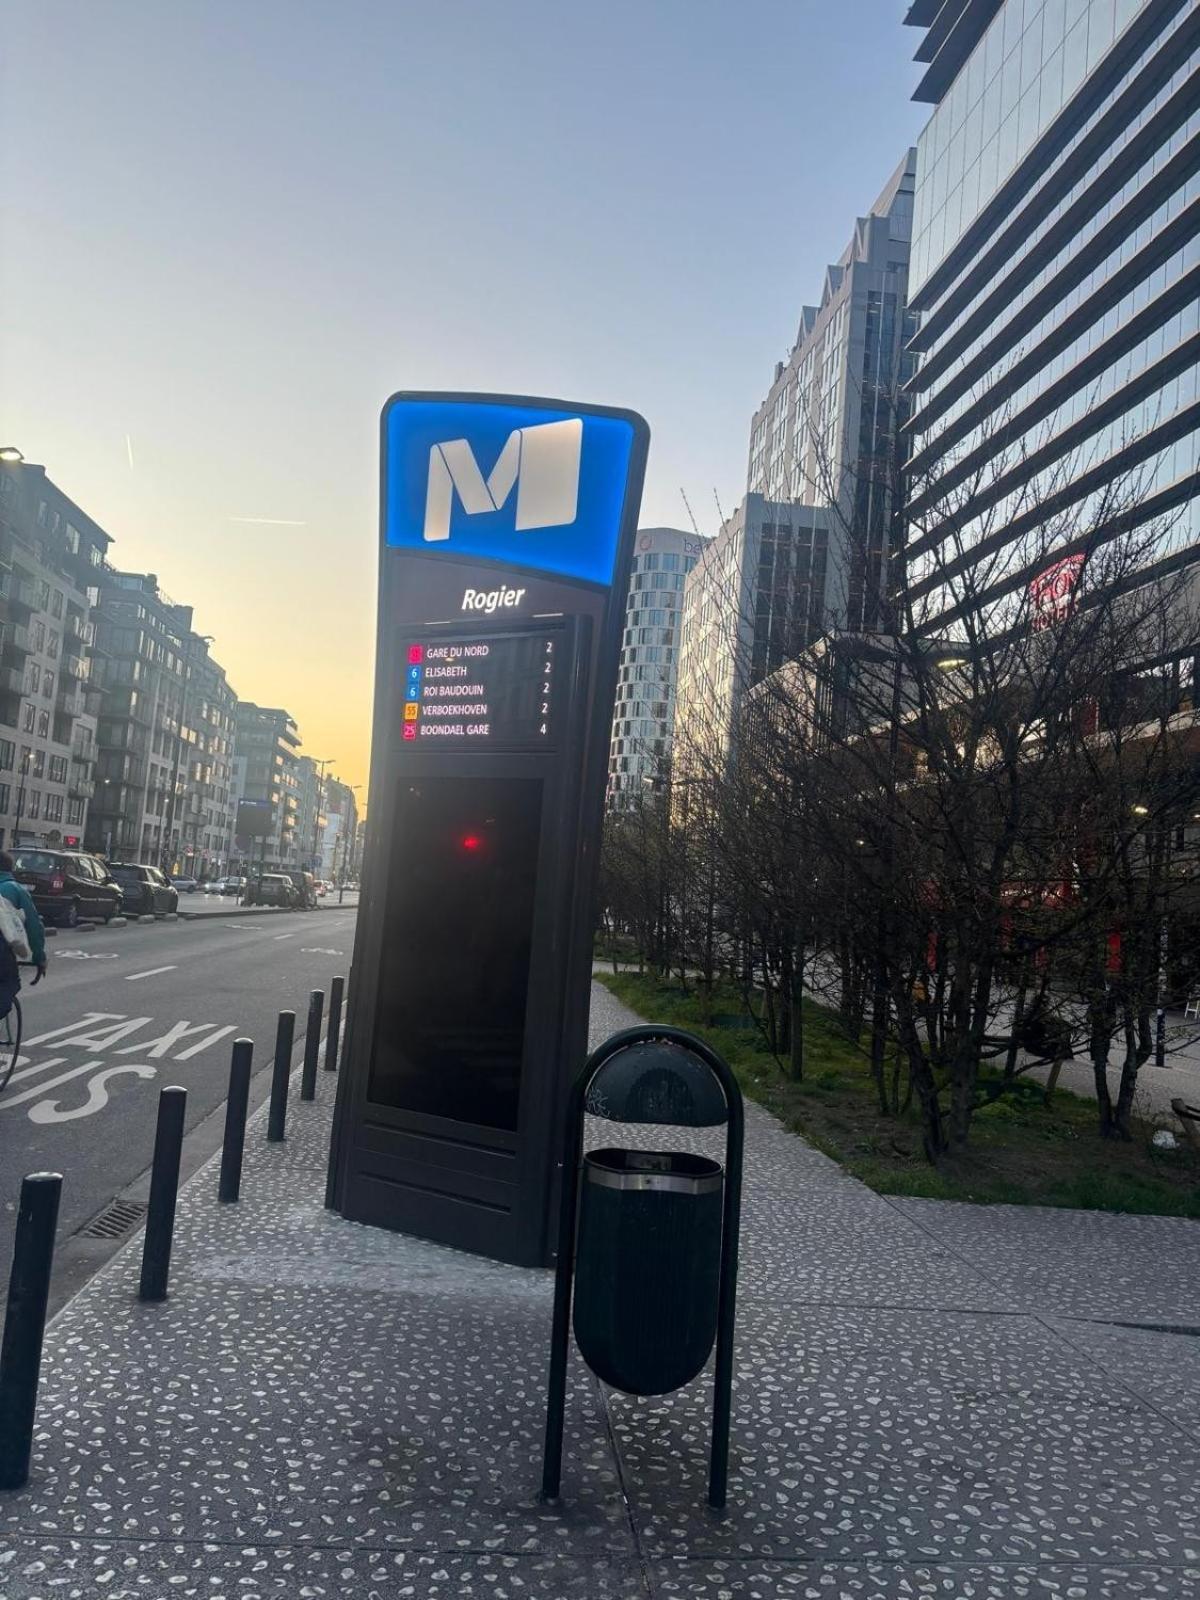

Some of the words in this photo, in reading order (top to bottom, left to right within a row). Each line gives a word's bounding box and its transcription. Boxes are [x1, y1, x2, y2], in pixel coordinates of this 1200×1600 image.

[462, 585, 526, 613] Rogier
[426, 648, 449, 659] GARE
[450, 647, 462, 657] DU
[464, 645, 489, 657] NORD
[546, 642, 552, 653] 2
[411, 668, 417, 679] 6
[425, 666, 467, 678] ELISABETH
[544, 662, 551, 673] 2
[409, 687, 416, 697] 6
[423, 685, 438, 697] ROI
[439, 684, 484, 696] BAUDOUIN
[543, 682, 550, 693] 2
[422, 704, 487, 716] VERBOEKHOVEN
[541, 702, 548, 714] 2
[404, 725, 415, 736] 25
[420, 724, 465, 736] BOONDAEL
[466, 723, 489, 735] GARE
[540, 723, 546, 735] 4
[20, 1012, 239, 1060] TAXI
